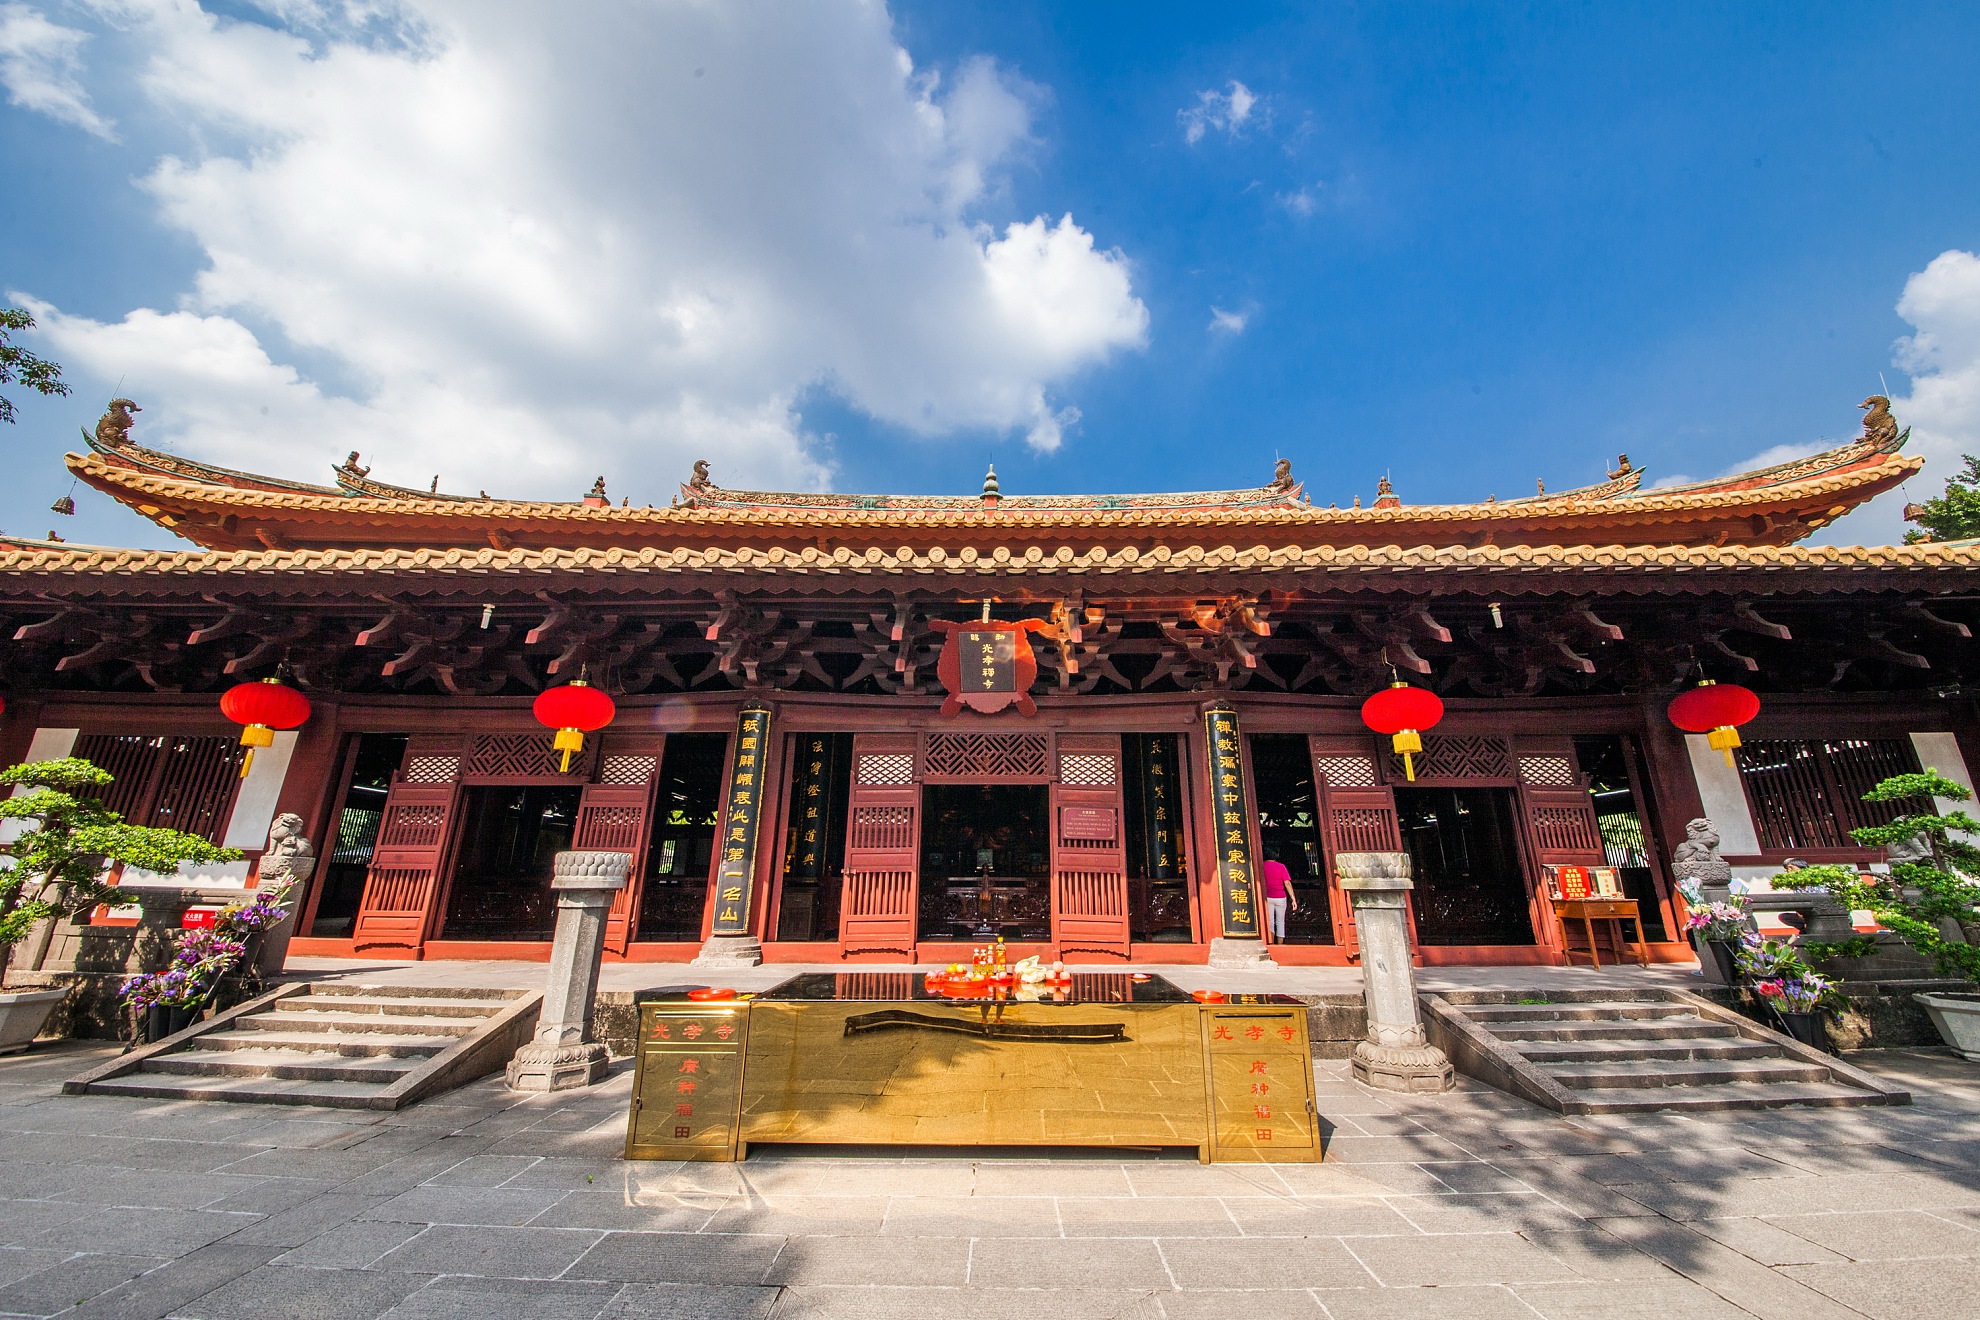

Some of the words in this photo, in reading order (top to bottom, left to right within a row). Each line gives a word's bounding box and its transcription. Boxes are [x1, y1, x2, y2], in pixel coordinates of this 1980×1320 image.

[651, 1024, 736, 1040] 光孝寺
[1213, 1025, 1297, 1041] 光孝寺
